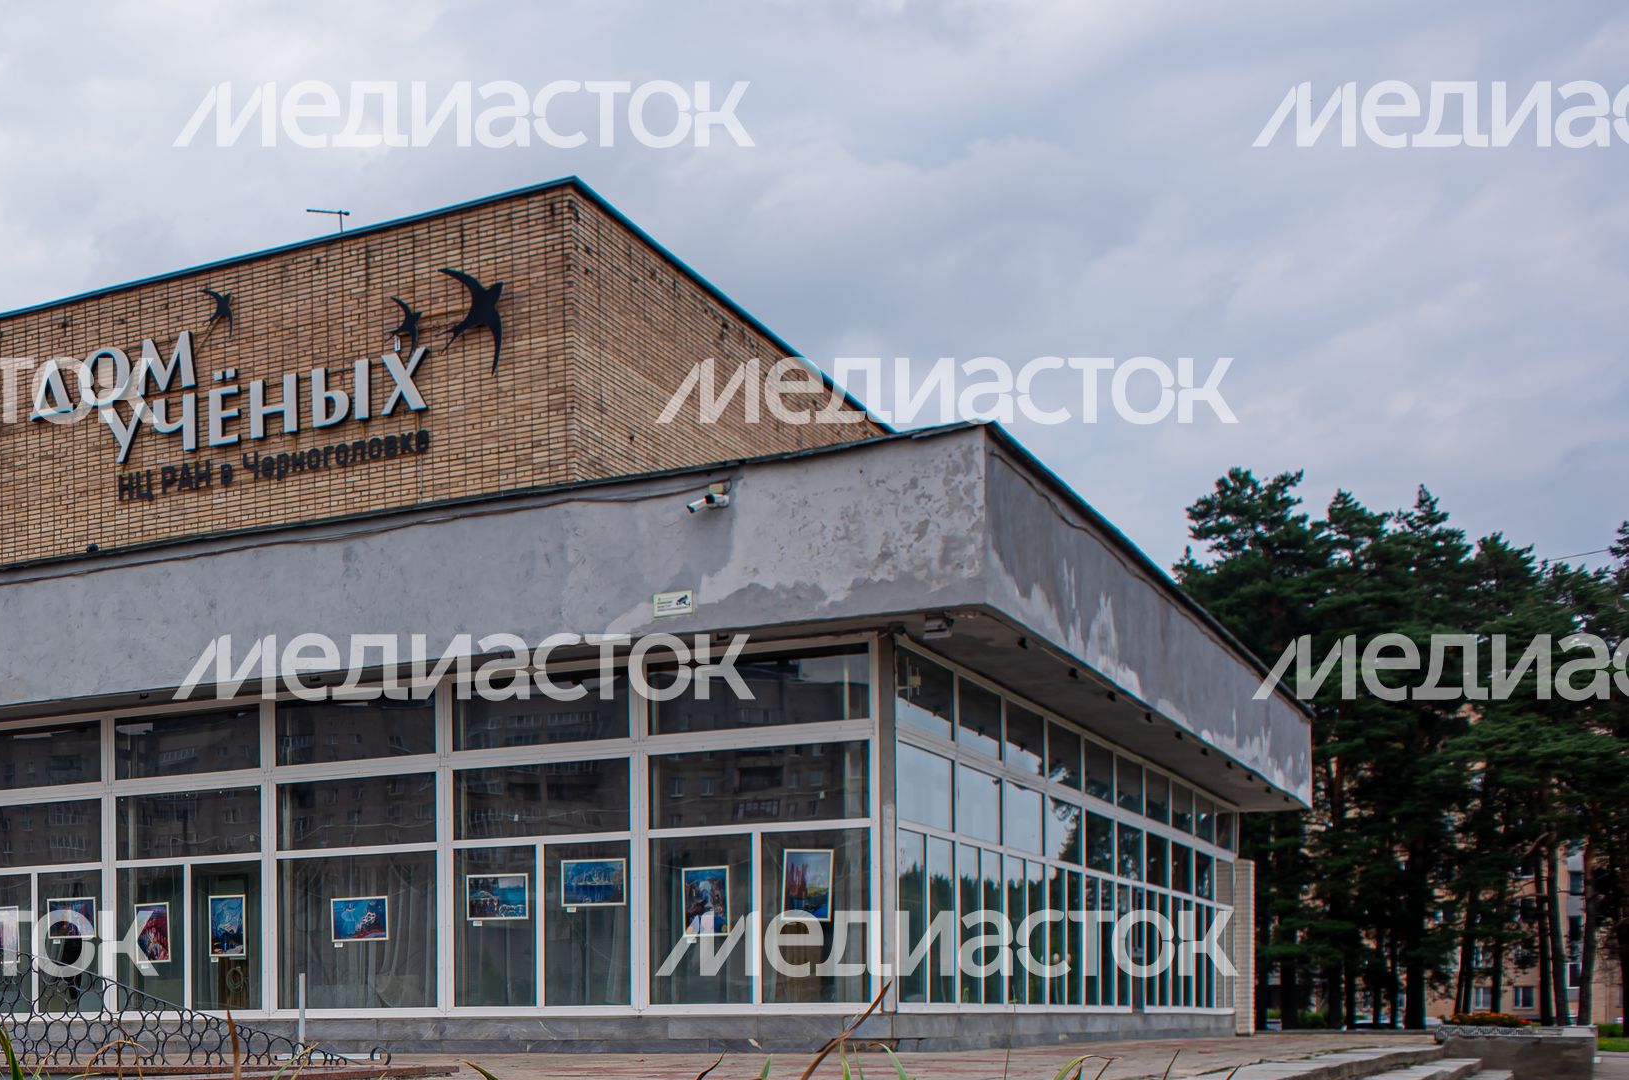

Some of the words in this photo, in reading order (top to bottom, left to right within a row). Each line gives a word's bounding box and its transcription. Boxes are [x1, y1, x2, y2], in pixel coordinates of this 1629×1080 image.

[31, 330, 197, 422] ДОМ
[102, 346, 432, 464] УЧЁНЫХ
[118, 468, 153, 501] НЦ
[161, 459, 212, 493] РАН
[220, 462, 233, 486] в
[242, 429, 431, 482] Черноголовке
